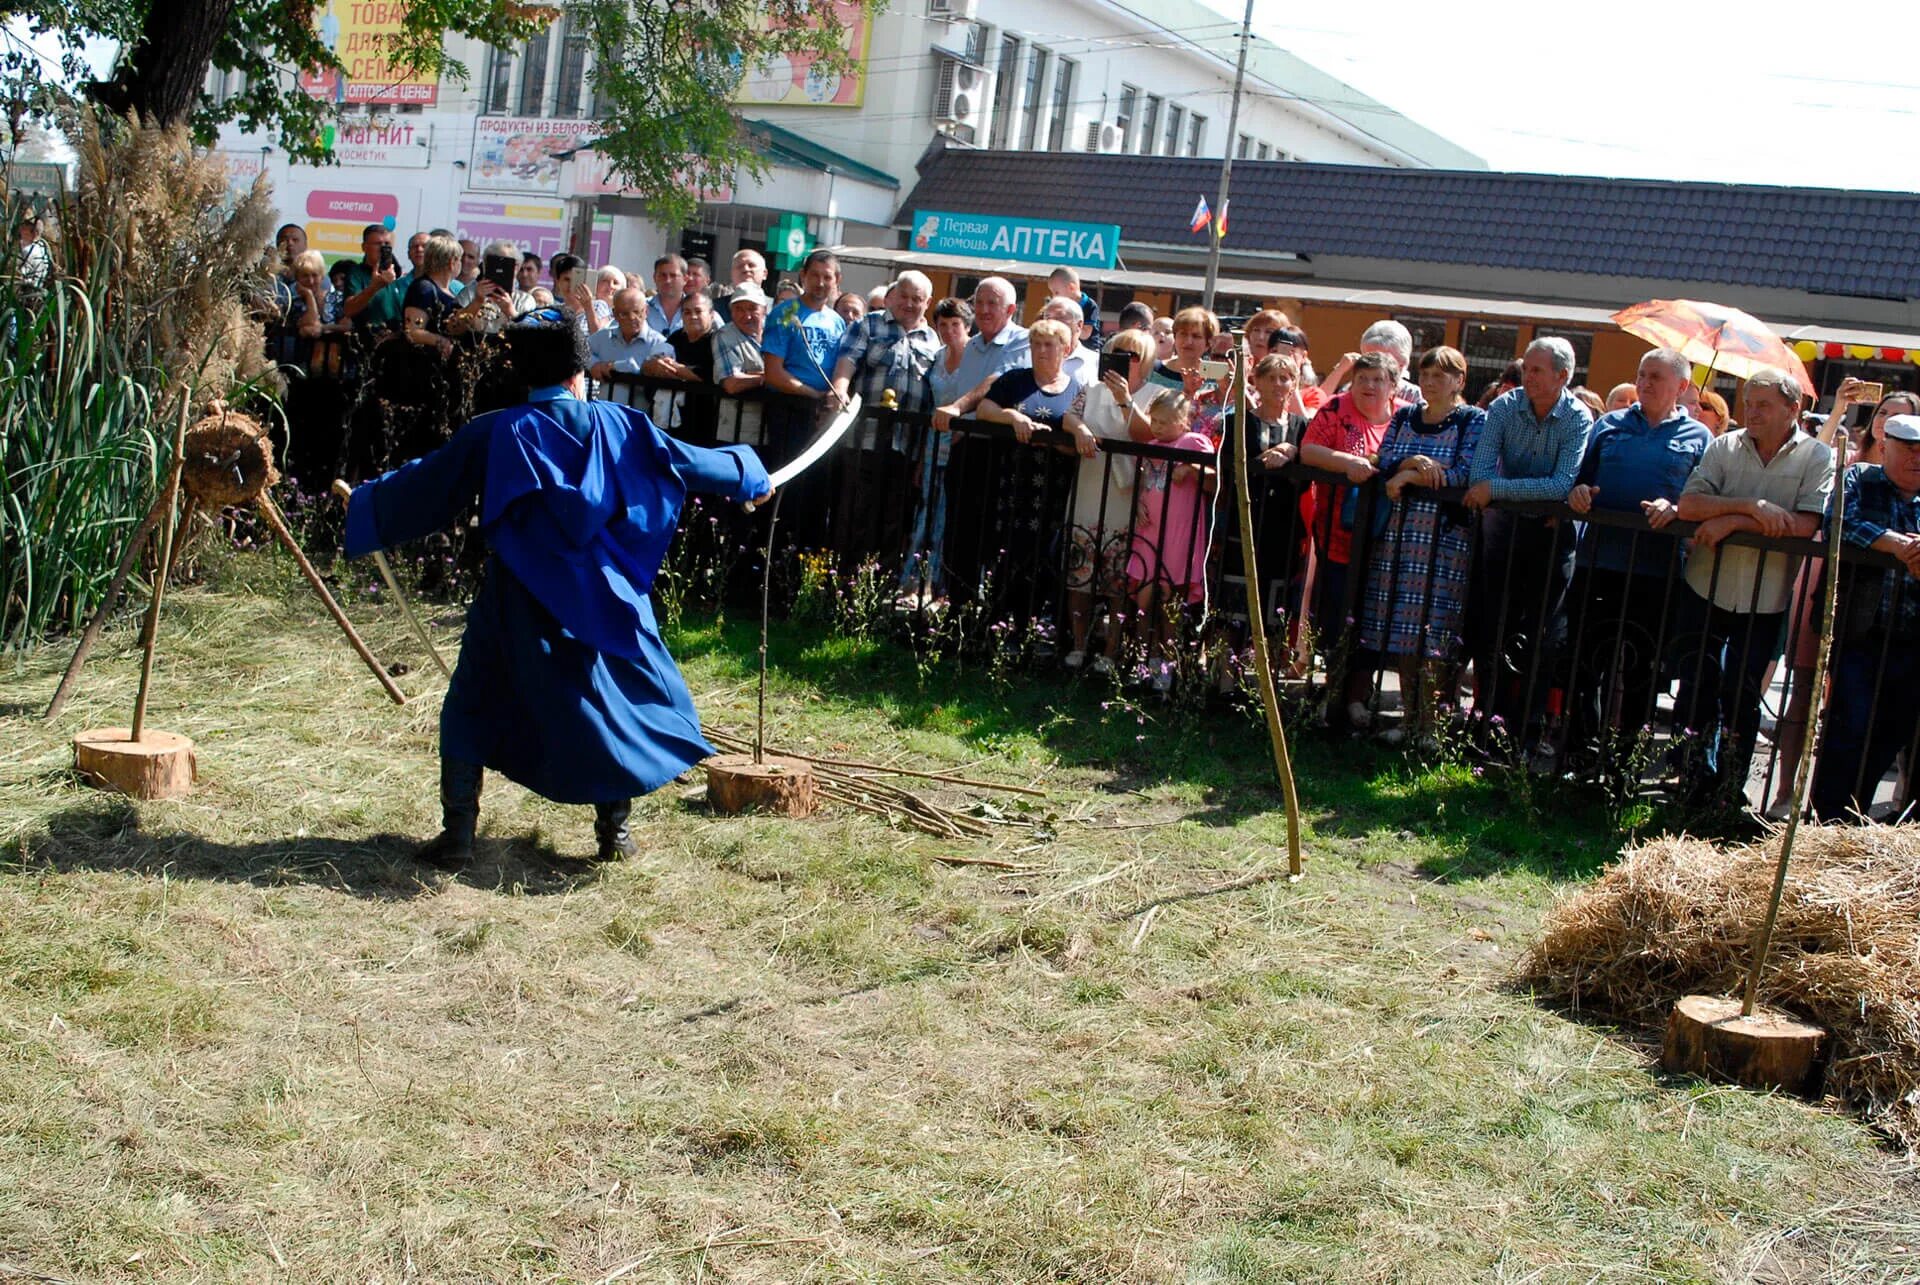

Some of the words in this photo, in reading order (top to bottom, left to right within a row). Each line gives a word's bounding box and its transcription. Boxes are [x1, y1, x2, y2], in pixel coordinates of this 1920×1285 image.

[348, 84, 398, 99] ОПТОВЫЕ
[400, 86, 433, 102] ЦЕНЫ
[479, 120, 534, 134] ПРОДУКТЫ
[536, 122, 550, 133] ИЗ
[944, 217, 989, 235] Первая
[939, 235, 989, 250] помощь
[990, 225, 1106, 261] АПТЕКА
